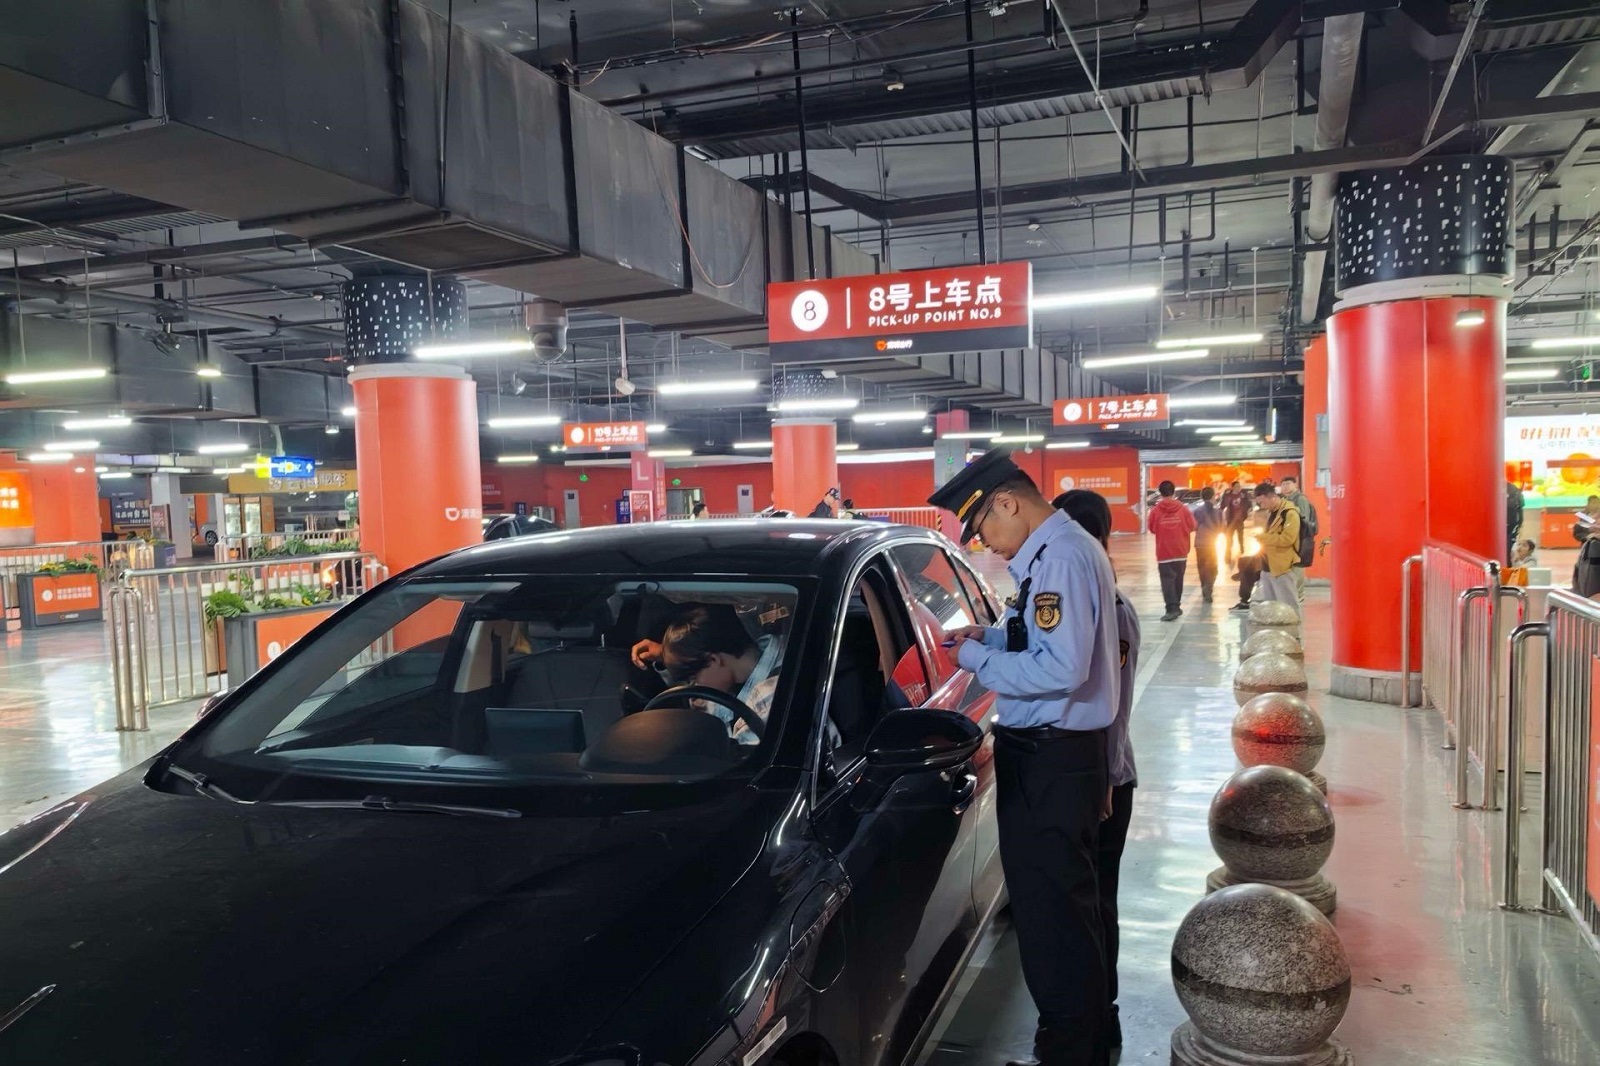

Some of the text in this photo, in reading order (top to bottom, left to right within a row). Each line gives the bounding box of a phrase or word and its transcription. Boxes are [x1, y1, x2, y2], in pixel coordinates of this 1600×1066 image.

[868, 275, 1003, 312] 8号上车点
[804, 300, 816, 321] 8
[868, 307, 1002, 327] PICK-UP POINT NO.8
[1098, 398, 1158, 414] 7号上车点
[636, 461, 649, 480] L
